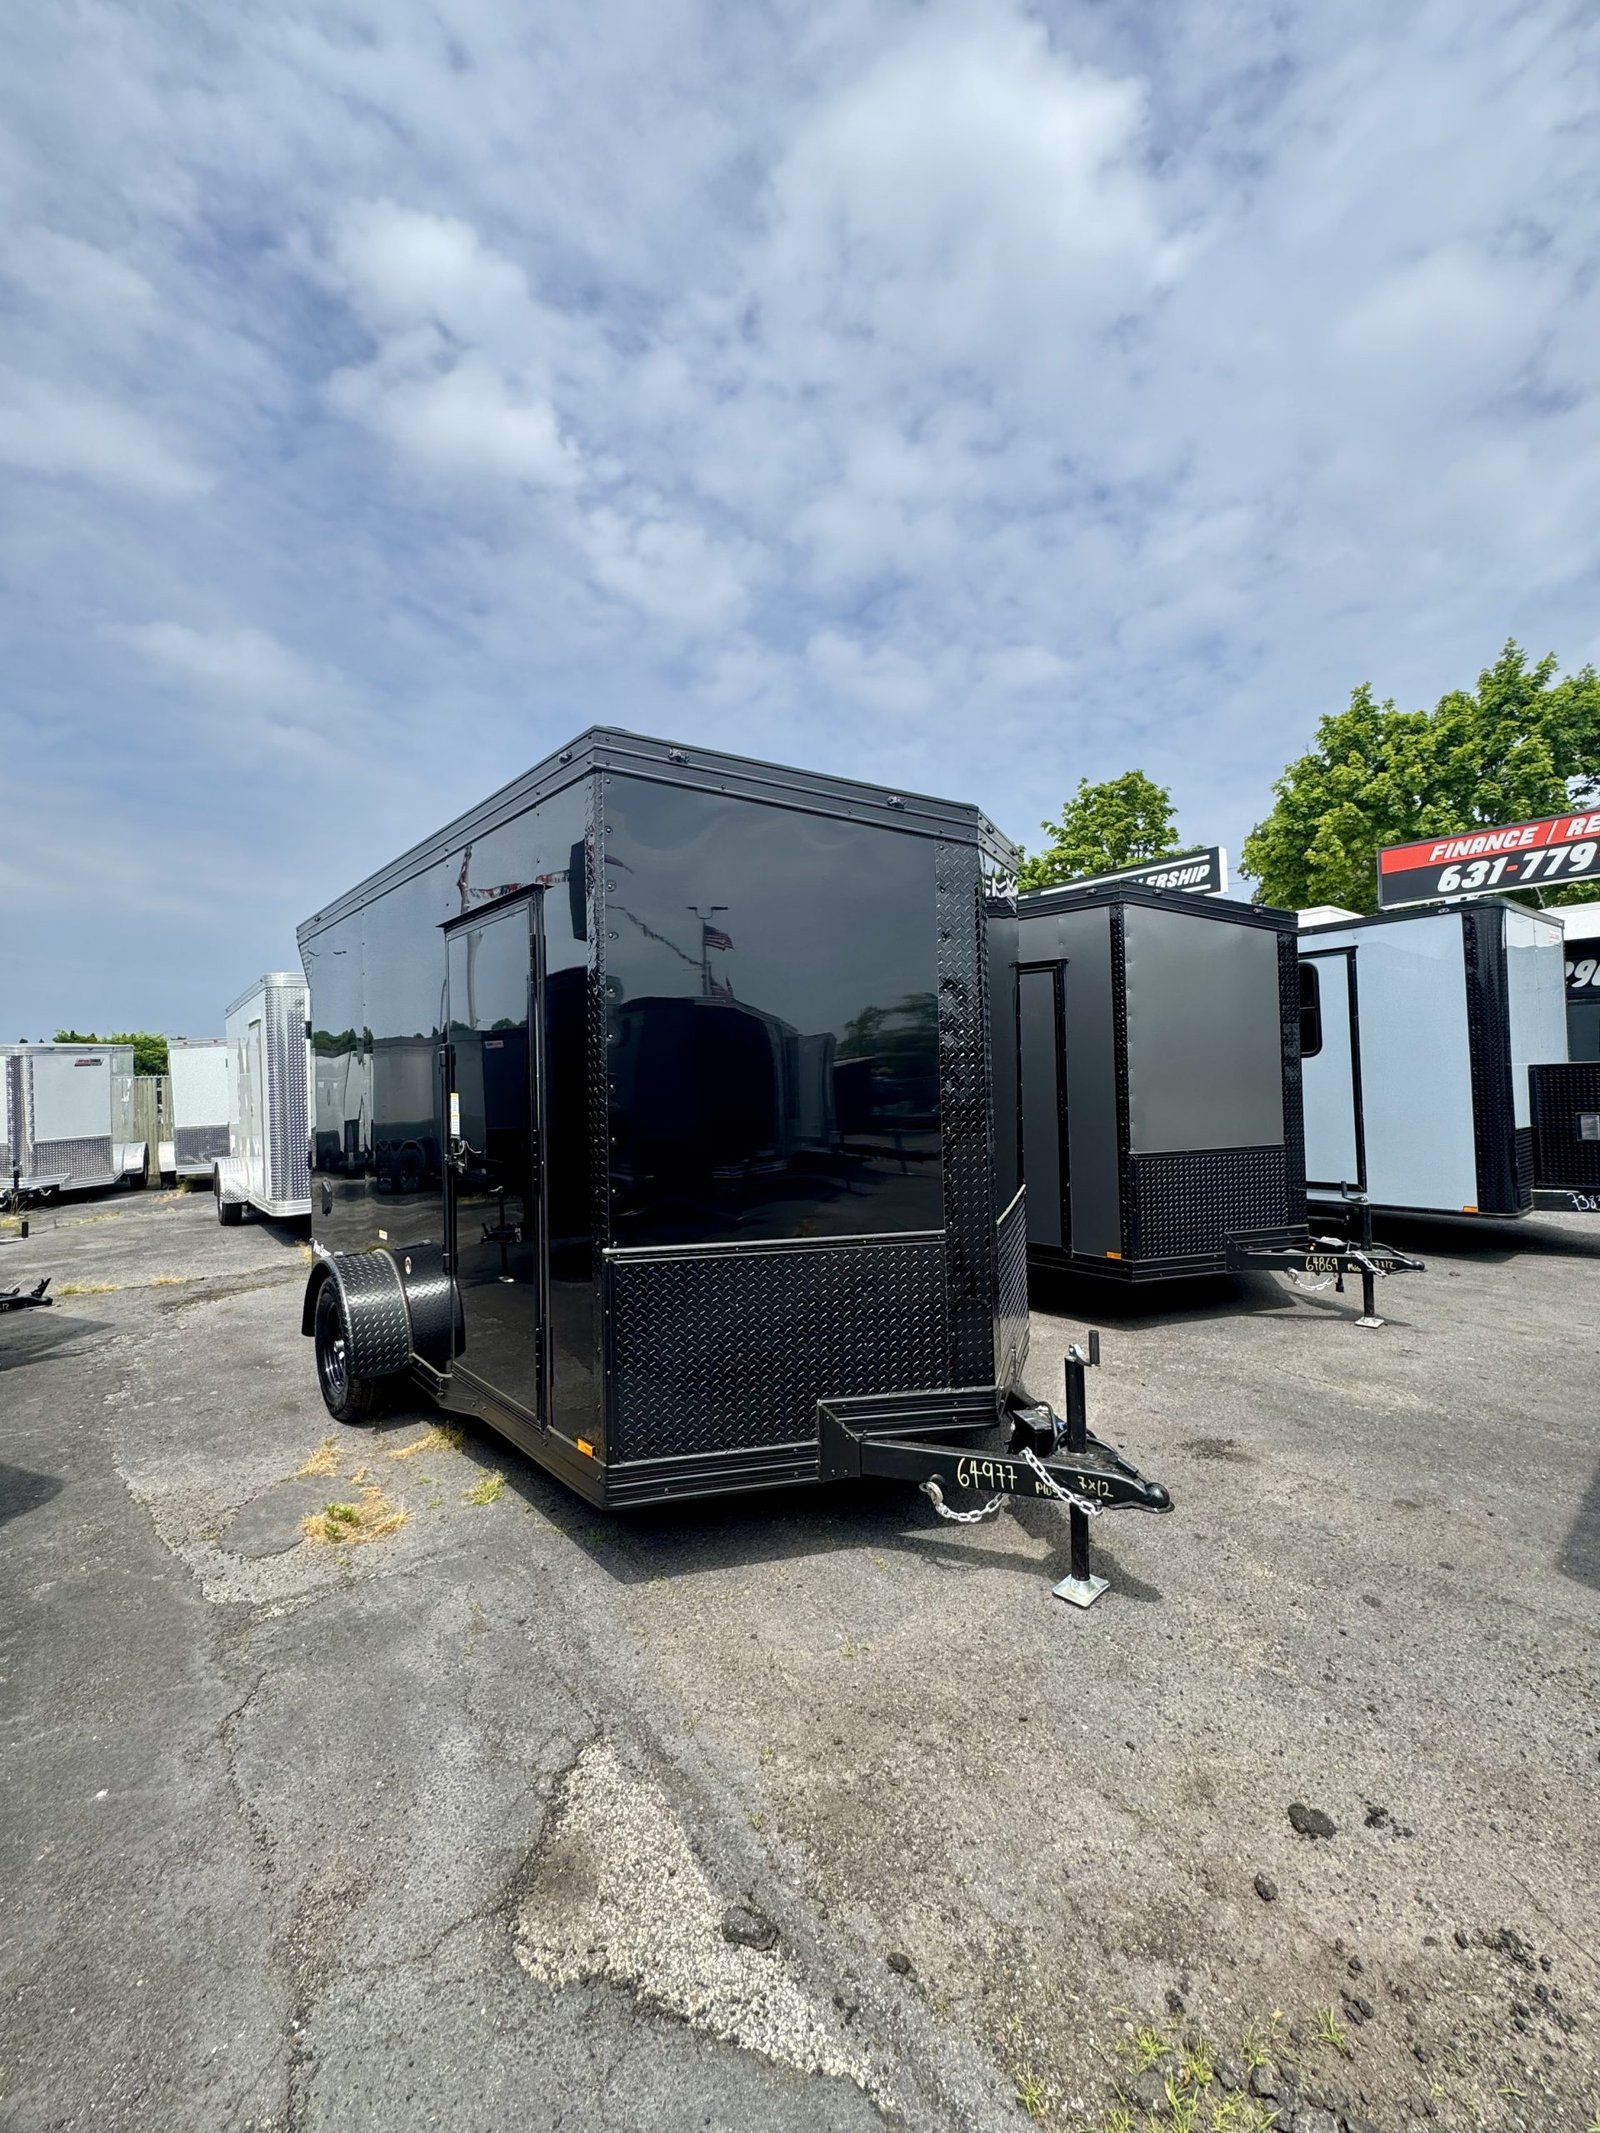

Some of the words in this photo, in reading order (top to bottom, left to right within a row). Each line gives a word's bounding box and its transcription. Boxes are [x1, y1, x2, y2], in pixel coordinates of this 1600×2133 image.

[1429, 826, 1540, 862] FINANCE
[1132, 864, 1211, 888] ERSHIP
[1305, 1255, 1339, 1272] 64869
[956, 1457, 1018, 1490] 64977
